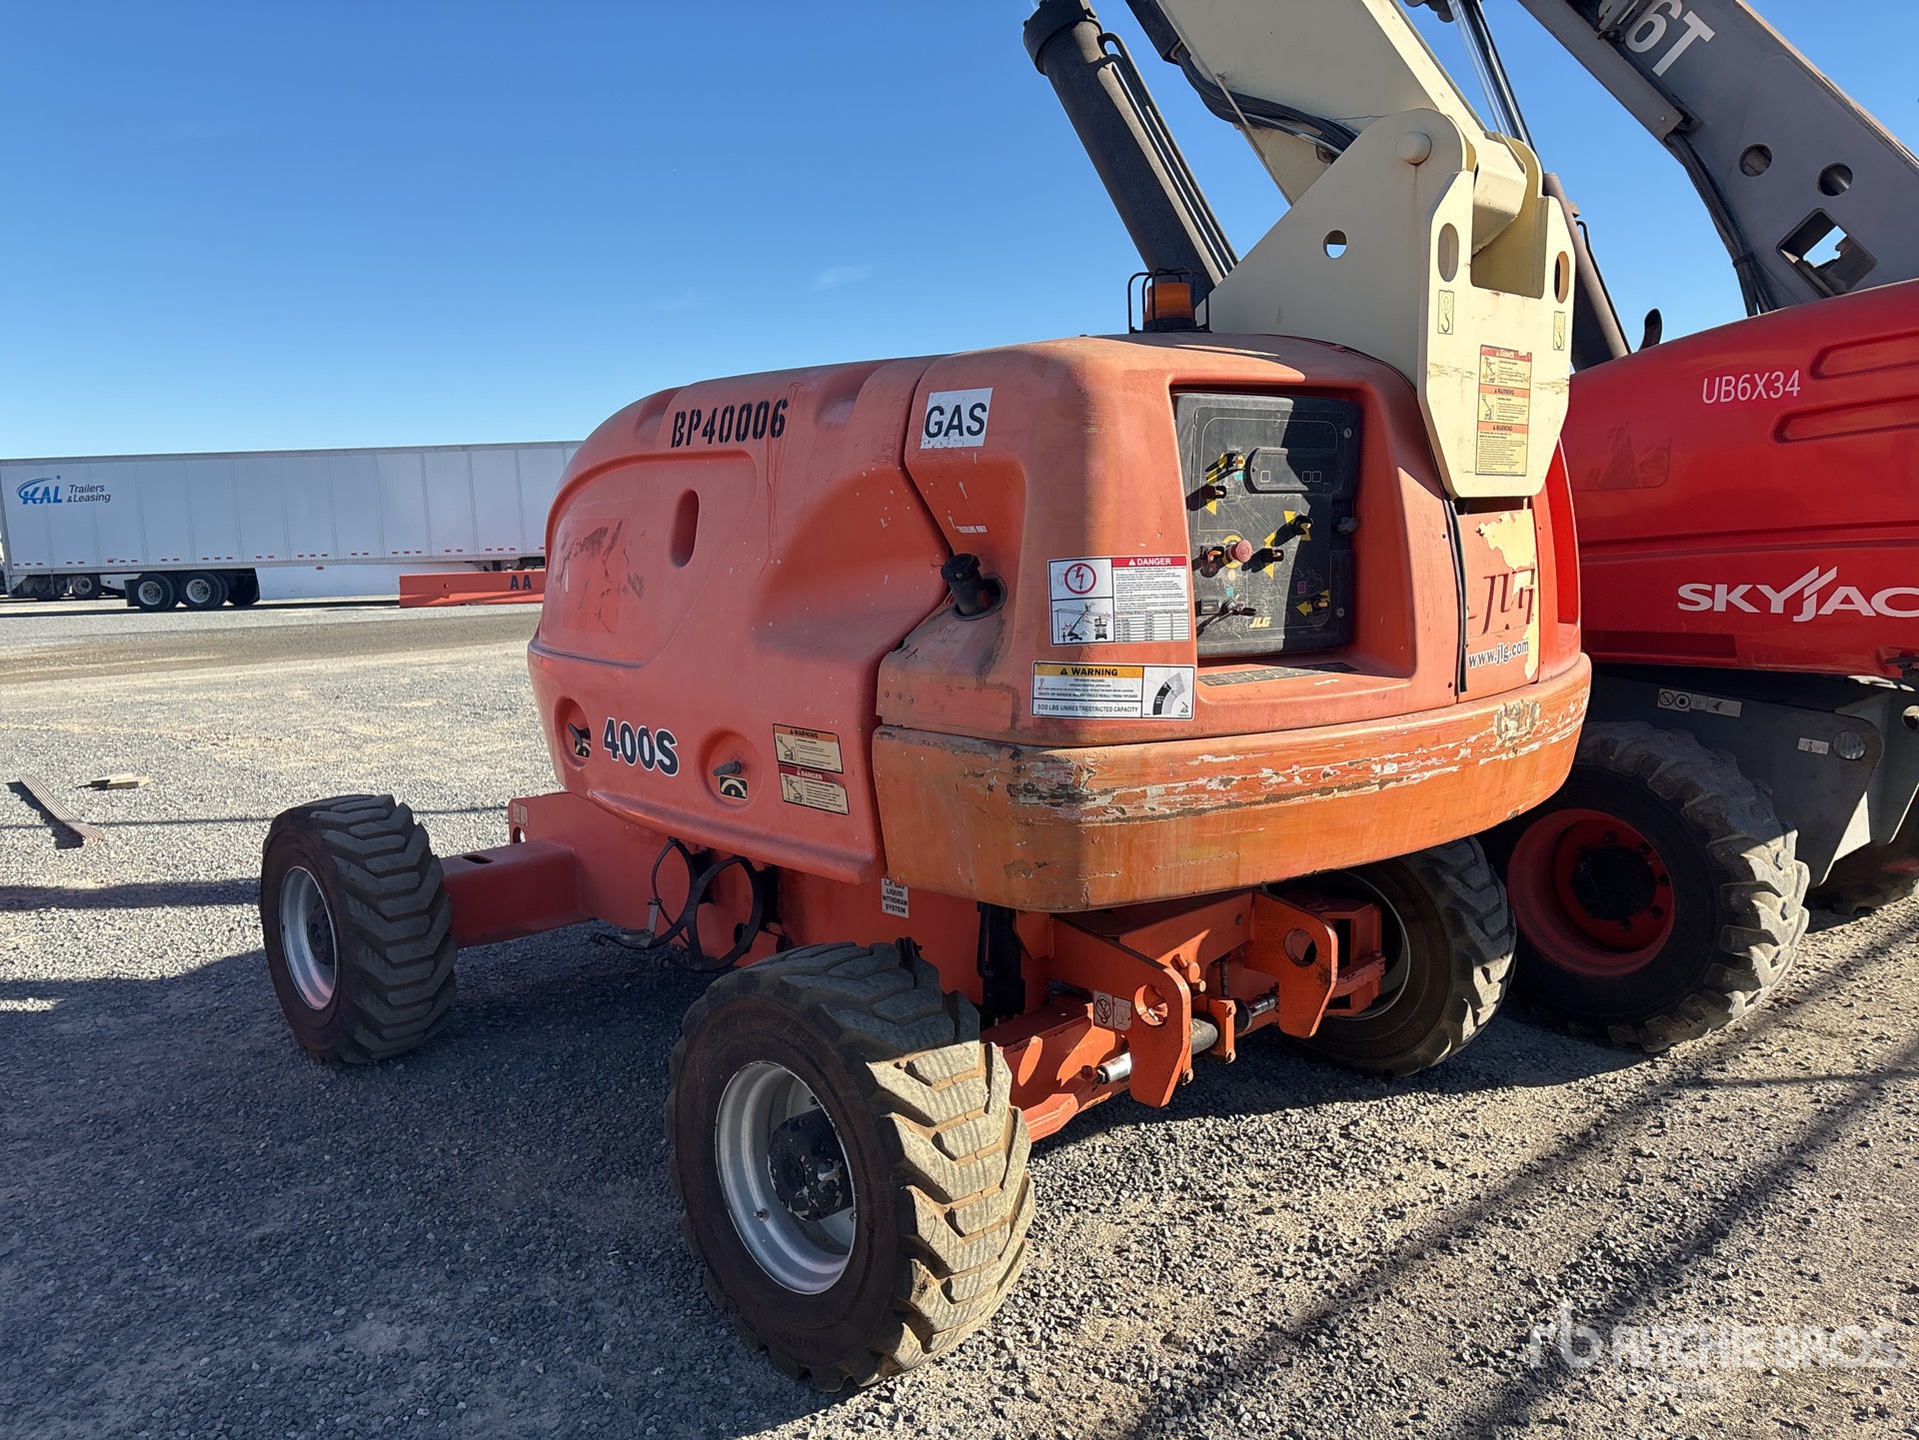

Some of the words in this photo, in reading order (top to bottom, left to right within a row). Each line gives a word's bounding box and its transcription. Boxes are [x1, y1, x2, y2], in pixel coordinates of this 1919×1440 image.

[1702, 369, 1801, 404] UB6X34
[671, 399, 789, 448] BP40006
[924, 402, 988, 439] GAS
[22, 485, 63, 505] KAL
[69, 484, 105, 494] Trailers
[1136, 557, 1172, 566] DANGER
[1249, 616, 1272, 629] JLG
[1468, 640, 1529, 668] www.jlg.com
[1071, 667, 1118, 677] WARNING
[603, 716, 681, 777] 400S
[885, 903, 906, 913] SYSTEM
